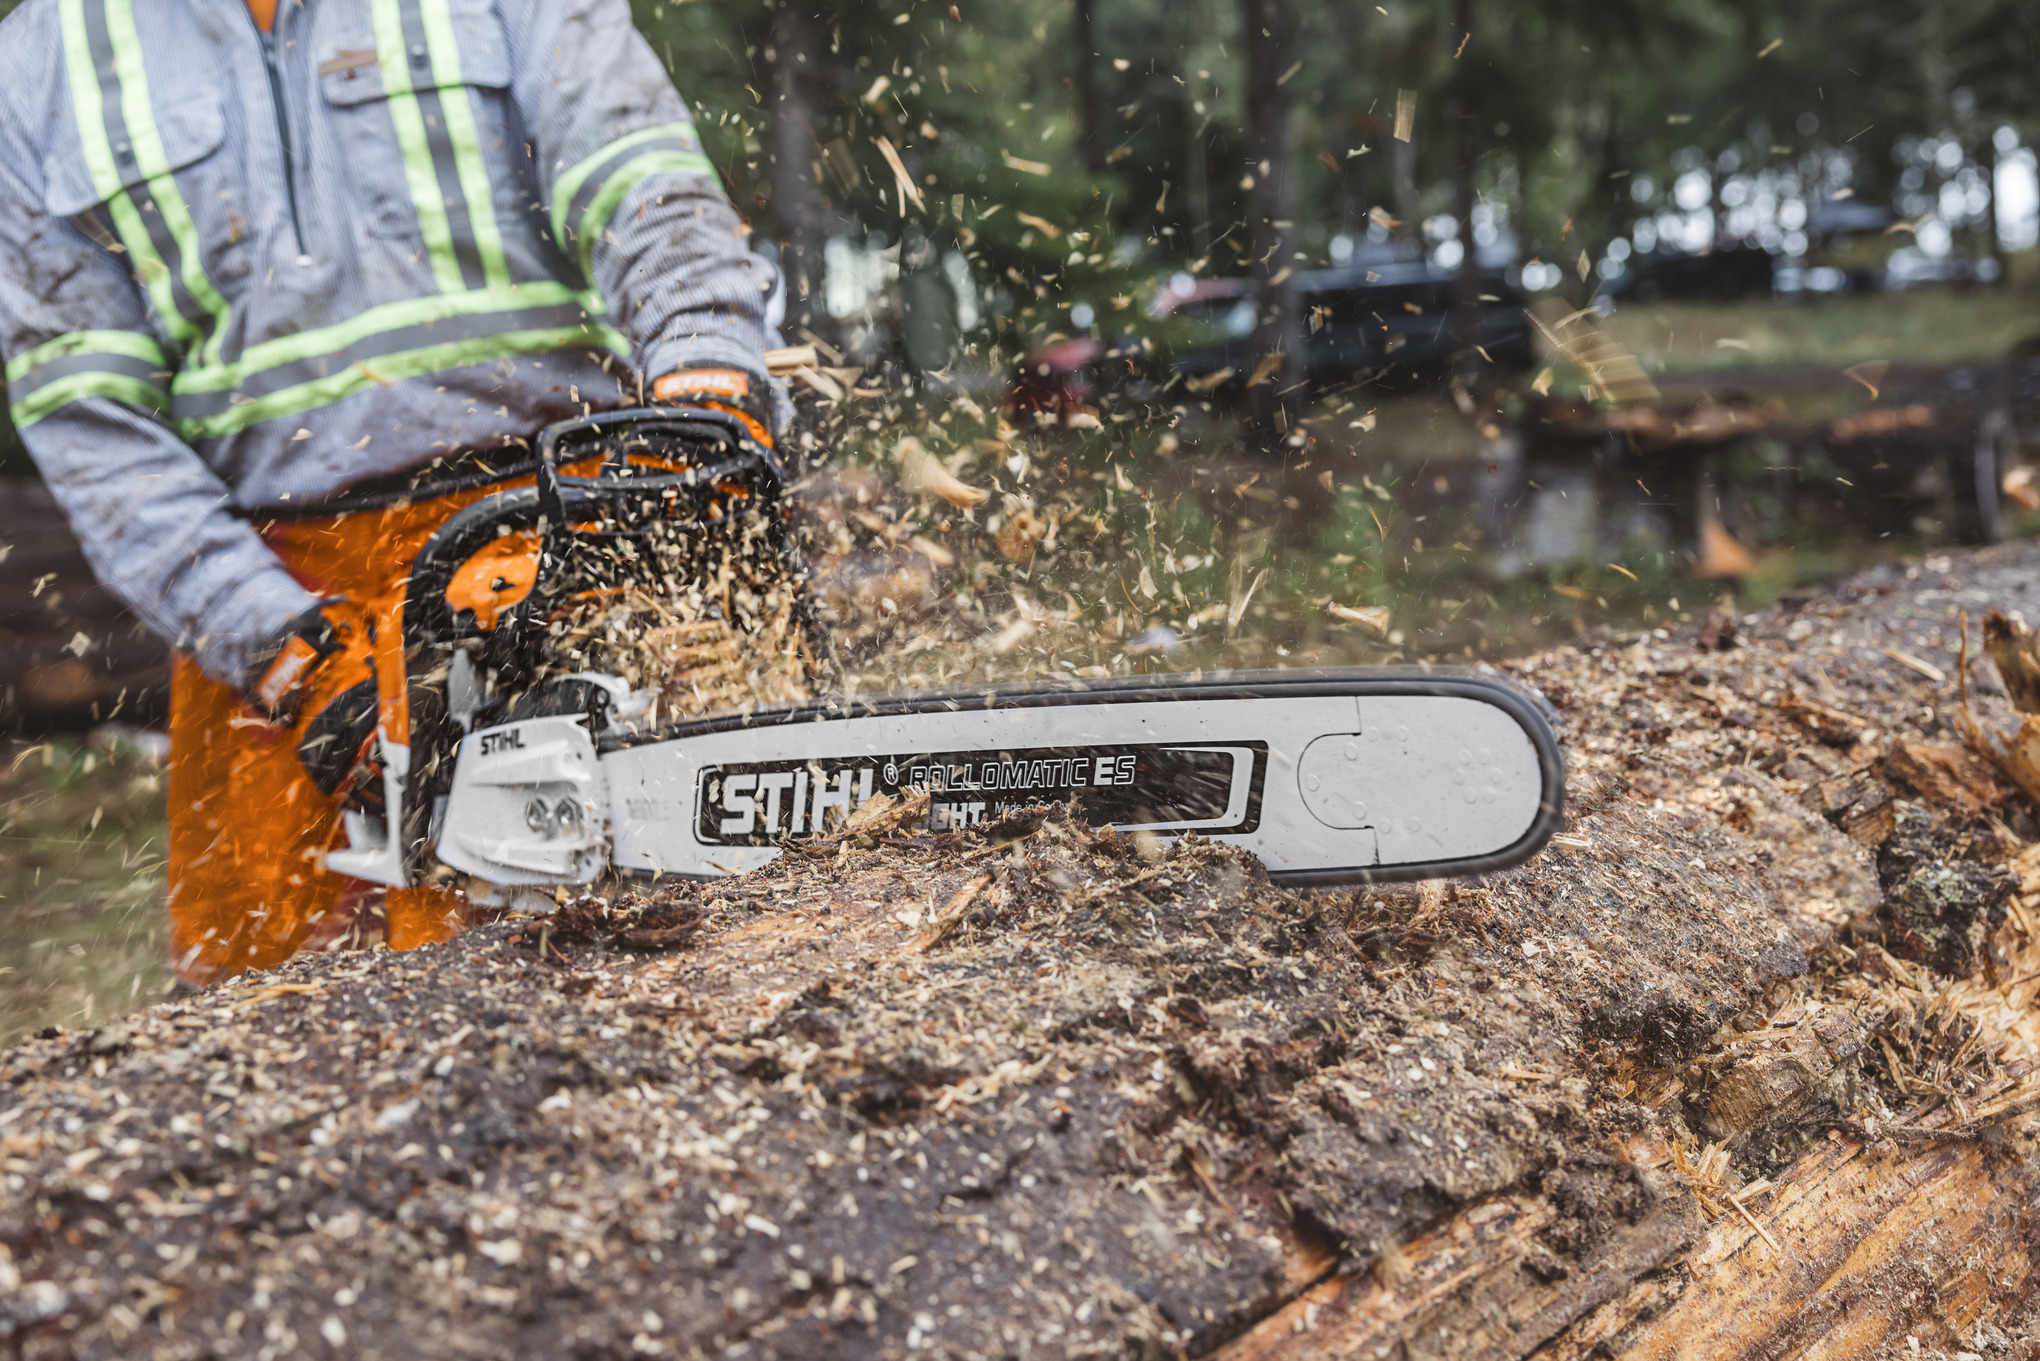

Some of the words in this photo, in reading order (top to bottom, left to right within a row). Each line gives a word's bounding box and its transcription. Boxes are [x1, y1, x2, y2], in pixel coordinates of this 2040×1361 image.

[481, 728, 525, 756] STIHL
[909, 757, 1090, 792] ROLLOMATIC
[1093, 755, 1137, 786] ES
[912, 802, 987, 831] GHT
